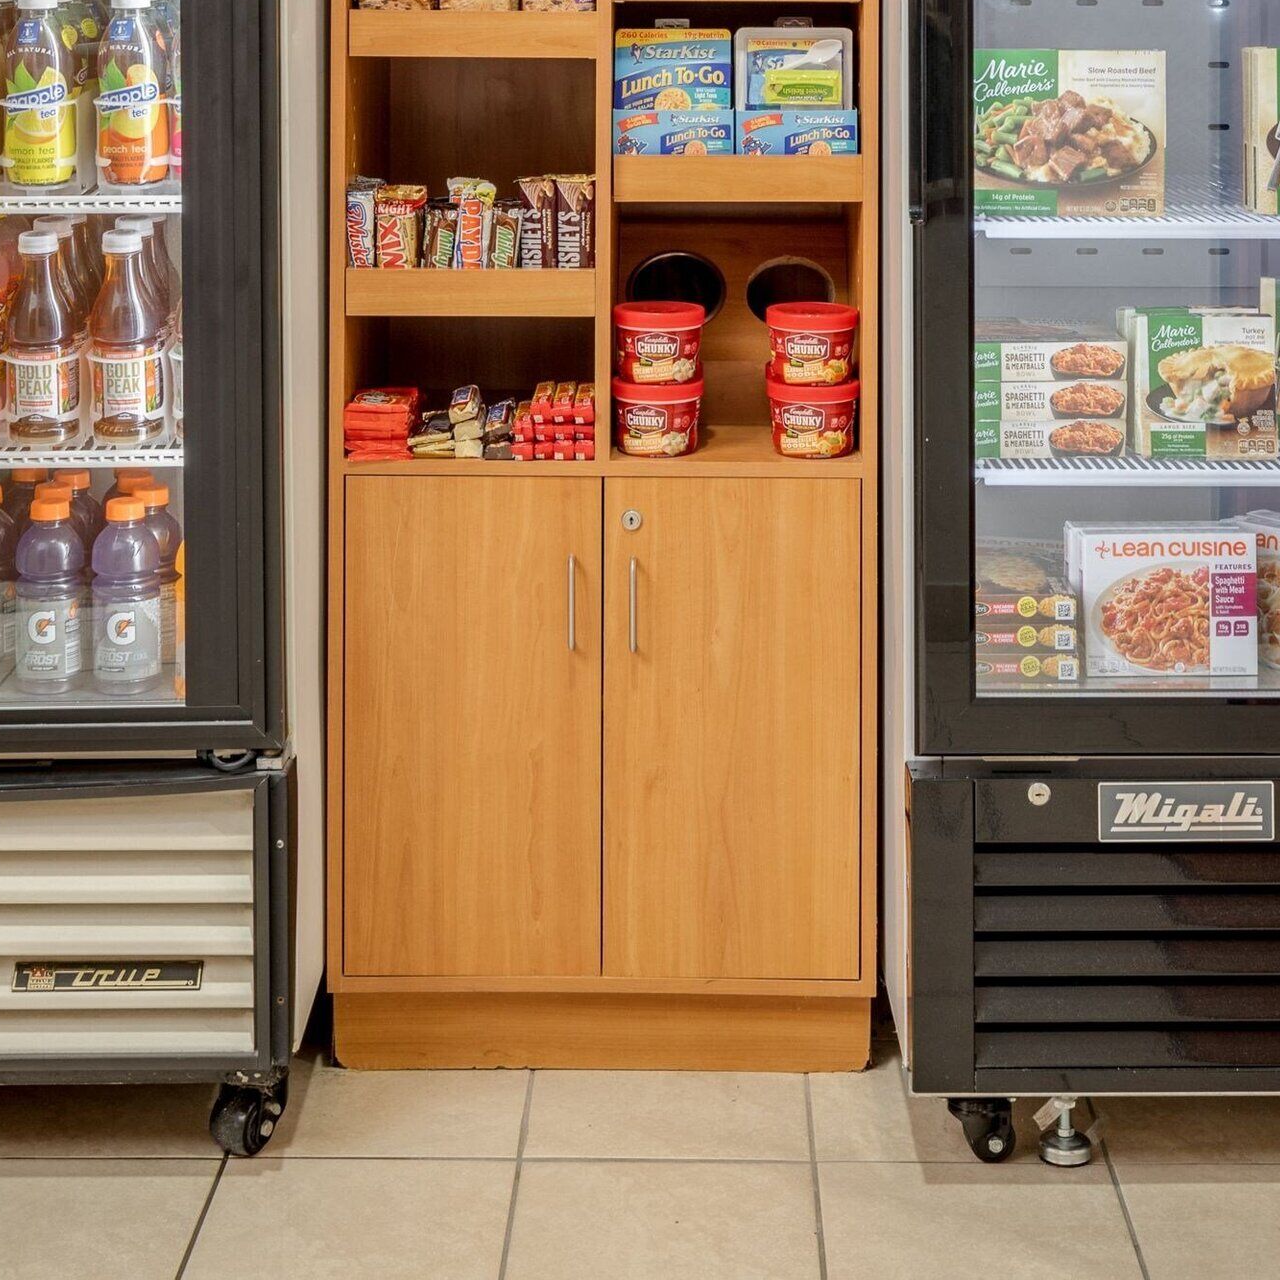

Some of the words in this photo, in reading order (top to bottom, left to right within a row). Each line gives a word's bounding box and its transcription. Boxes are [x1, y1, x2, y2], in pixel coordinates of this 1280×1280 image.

[645, 46, 717, 59] StarKist
[974, 59, 1048, 84] Marie
[622, 69, 672, 98] Lunch
[973, 79, 1053, 102] Callender's
[40, 110, 56, 118] tea
[132, 109, 148, 117] tea
[679, 115, 720, 123] StarKist
[803, 115, 845, 124] StarKist
[666, 131, 696, 146] Lunch
[697, 127, 725, 137] To-Go
[790, 131, 819, 146] Lunch
[822, 127, 850, 138] To-Go
[1152, 325, 1196, 340] Marie
[1242, 328, 1265, 336] Turkey
[638, 341, 677, 355] CHUNKY
[787, 342, 827, 355] CHUNKY
[1151, 338, 1200, 352] Callender's
[1005, 354, 1045, 362] SPAGHETTI
[19, 365, 51, 380] GOLD
[106, 363, 140, 379] GOLD
[1011, 362, 1045, 370] MEATBALLS
[19, 380, 53, 394] PEAK
[107, 380, 140, 393] PEAK
[1005, 393, 1045, 401] SPAGHETTI
[1011, 401, 1045, 409] MEATBALLS
[627, 415, 664, 428] CHUNKY
[784, 414, 823, 427] CHUNKY
[1004, 431, 1044, 439] SPAGHETTI
[1010, 439, 1044, 447] MEATBALLS
[1215, 576, 1245, 586] Spaghetti
[1215, 586, 1227, 594] with
[1229, 586, 1245, 594] Meat
[1215, 594, 1234, 604] Sauce
[28, 611, 56, 644] G
[107, 611, 136, 645] G
[25, 654, 61, 664] FROST
[1114, 792, 1260, 828] Migali
